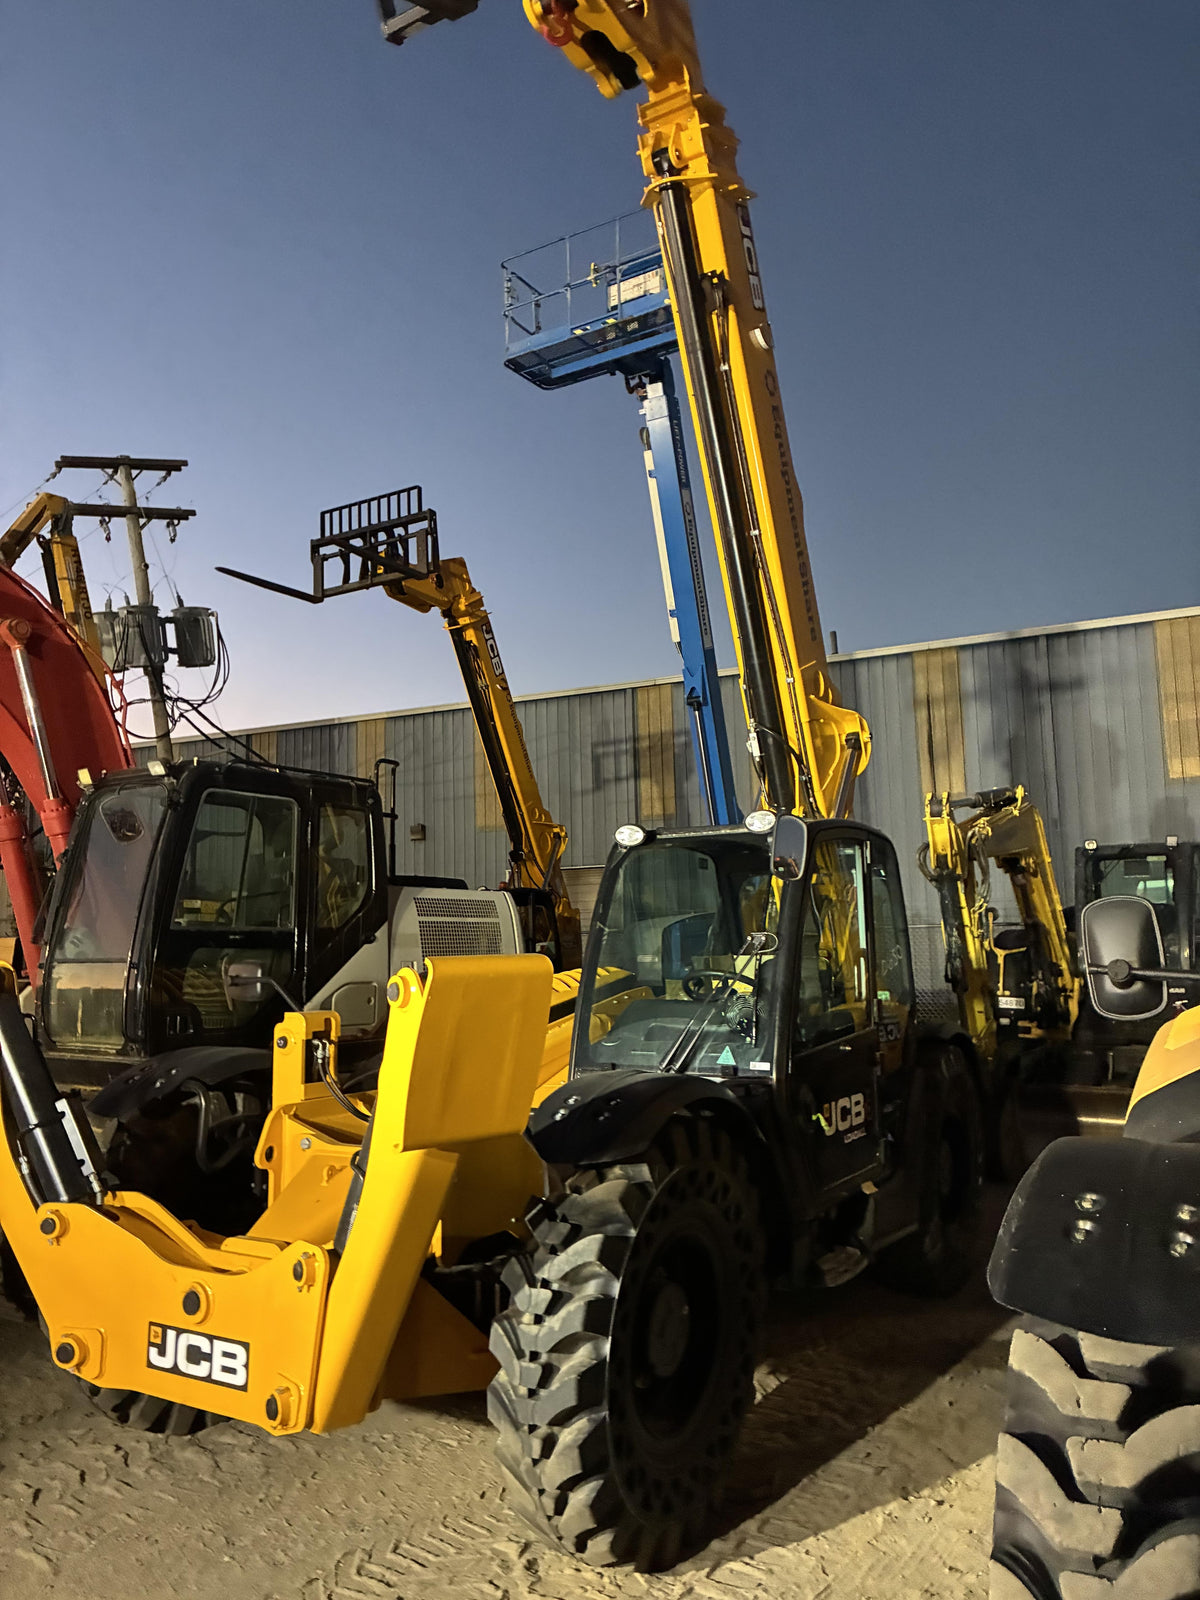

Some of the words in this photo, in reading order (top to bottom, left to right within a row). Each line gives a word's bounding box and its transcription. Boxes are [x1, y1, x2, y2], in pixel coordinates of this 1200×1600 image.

[736, 205, 764, 309] JCB
[771, 404, 818, 642] EquipmentShare
[482, 624, 503, 677] JCB
[824, 1092, 865, 1137] JCB
[148, 1328, 248, 1387] JCB
